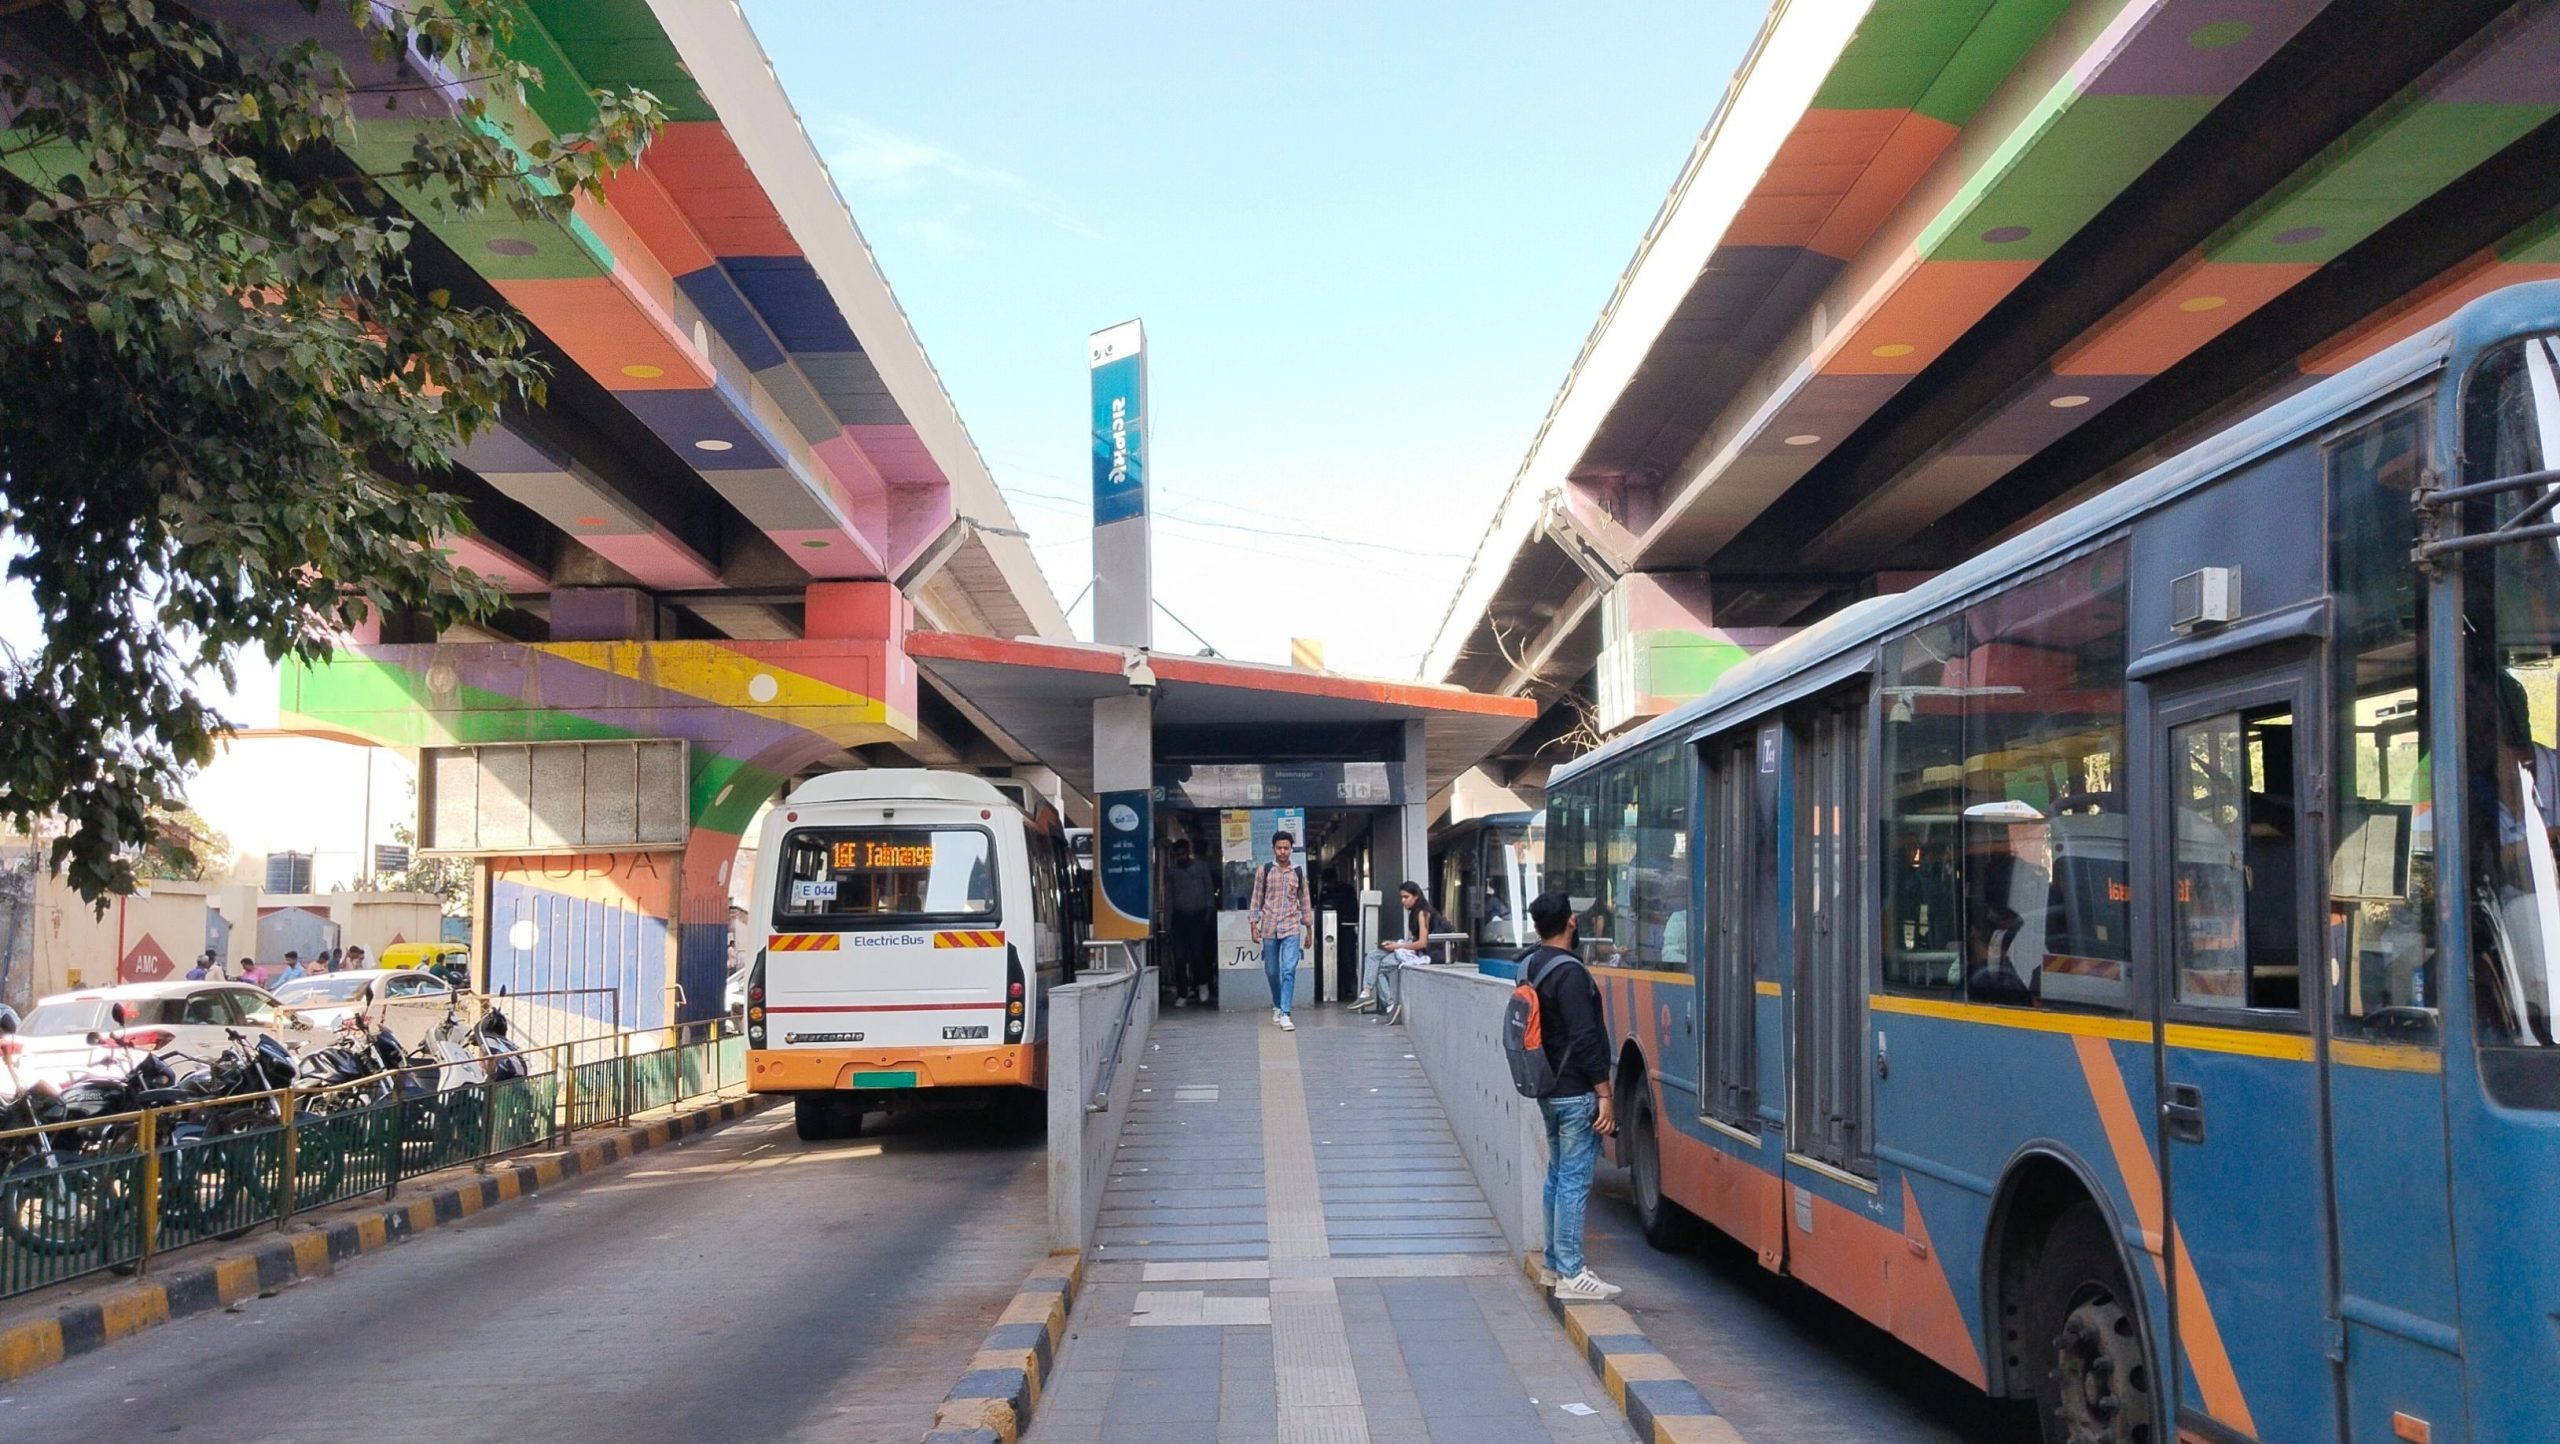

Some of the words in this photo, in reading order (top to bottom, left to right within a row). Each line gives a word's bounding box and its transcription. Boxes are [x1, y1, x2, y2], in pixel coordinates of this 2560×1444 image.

[832, 842, 856, 867] 16E
[499, 852, 659, 881] AUDA
[803, 885, 811, 896] E
[814, 885, 834, 896] 044
[854, 936, 899, 947] Electric
[901, 935, 924, 946] Bus
[135, 955, 158, 974] AMC
[944, 1026, 987, 1039] TATA
